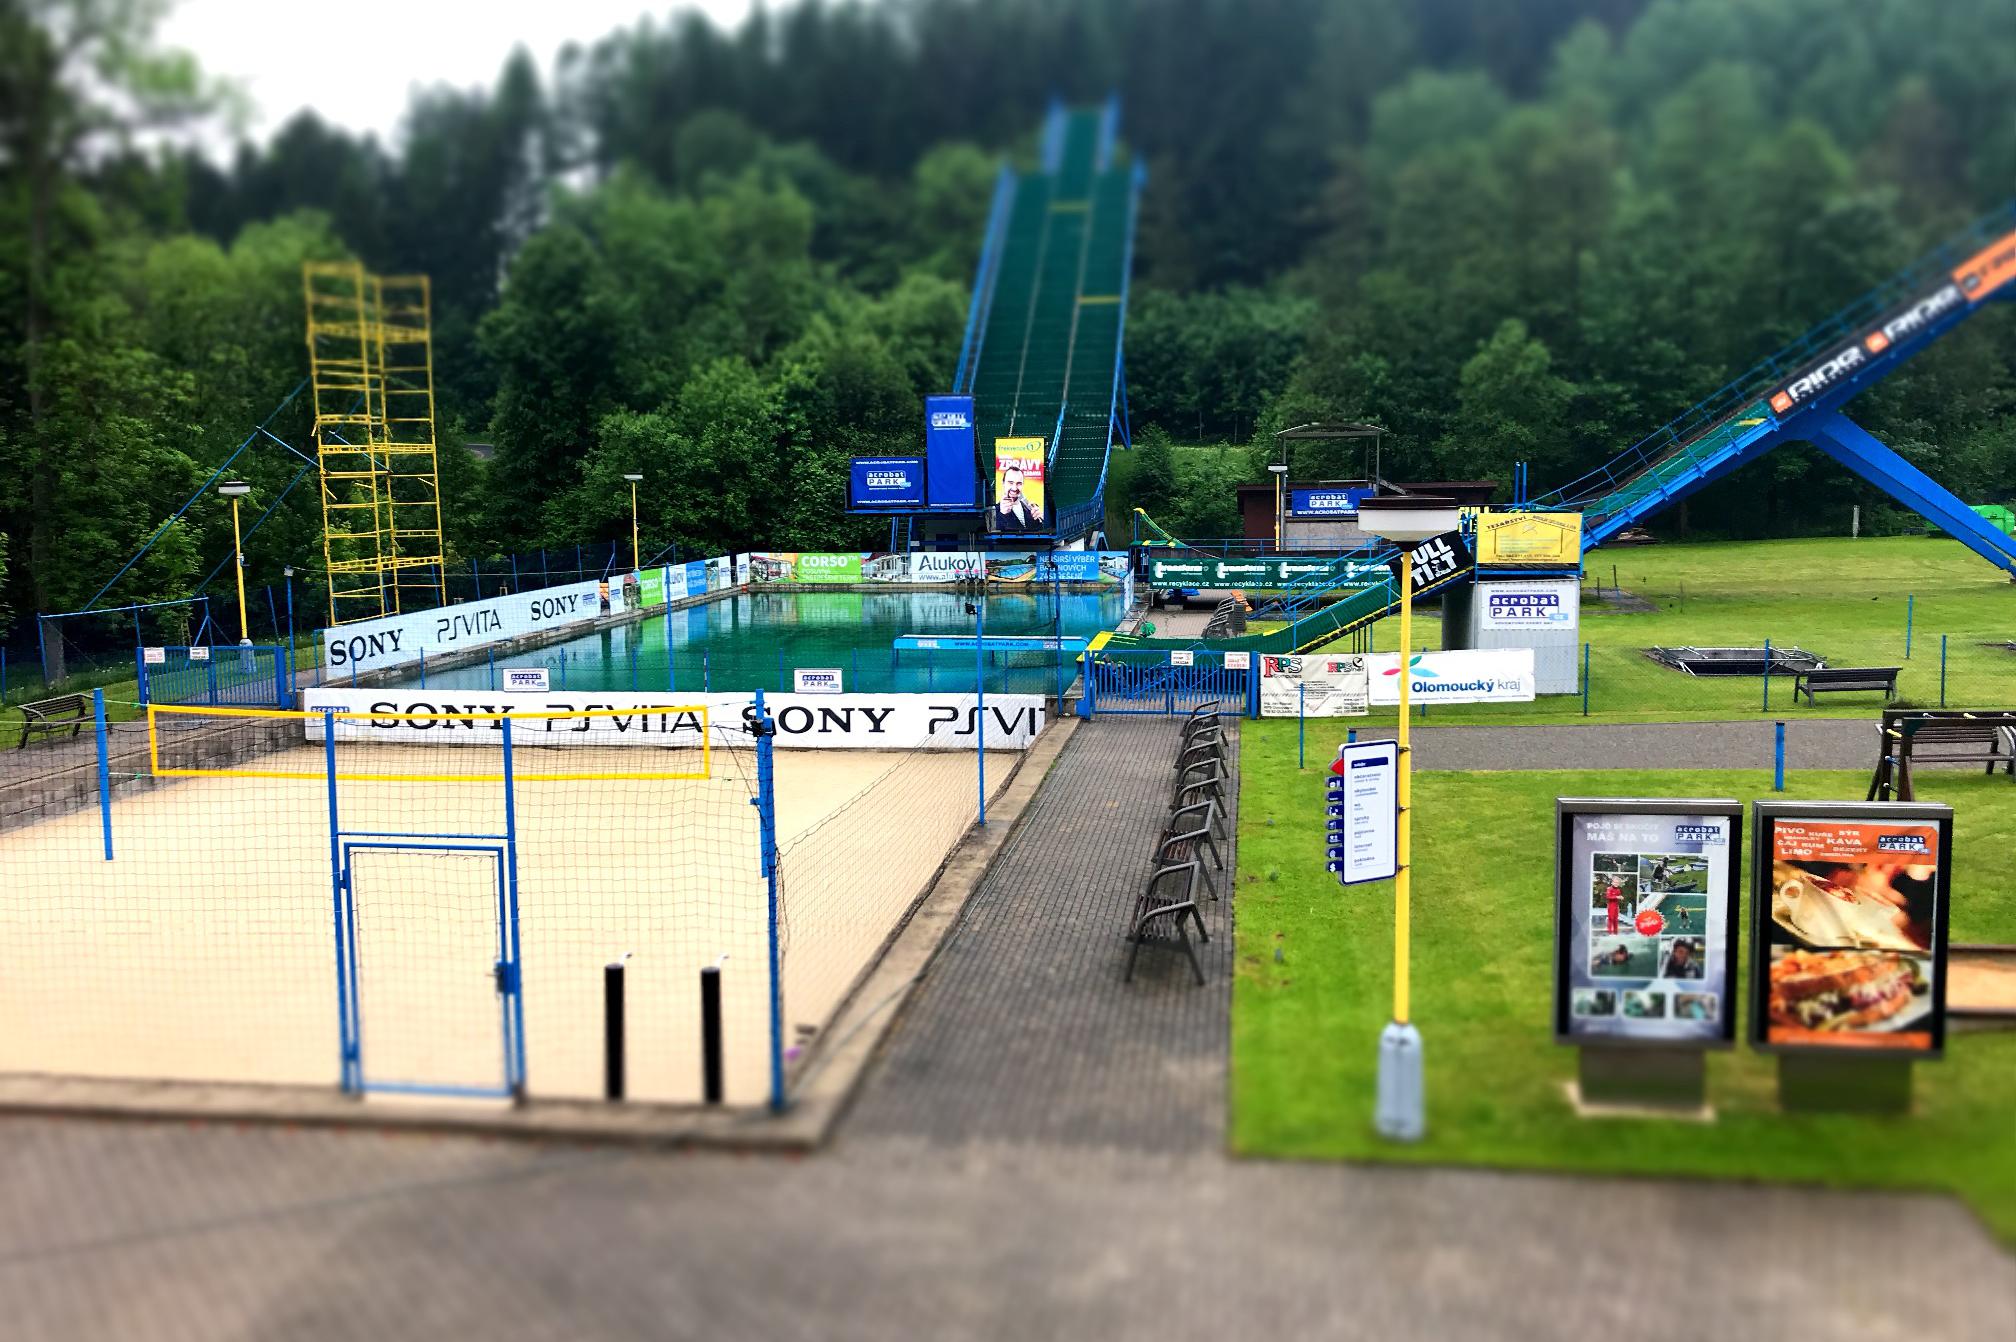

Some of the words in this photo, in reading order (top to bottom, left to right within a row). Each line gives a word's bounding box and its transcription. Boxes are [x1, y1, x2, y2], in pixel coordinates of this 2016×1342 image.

[1401, 537, 1451, 567] ULL
[919, 555, 976, 571] Alukov
[1492, 596, 1557, 605] acrobat
[1492, 607, 1546, 616] PARK
[330, 629, 403, 666] SONY
[530, 594, 579, 621] SONY
[1264, 657, 1302, 678] RPS
[1411, 679, 1495, 693] Olomoucký
[1497, 679, 1521, 692] kraj
[1641, 833, 1659, 842] TO
